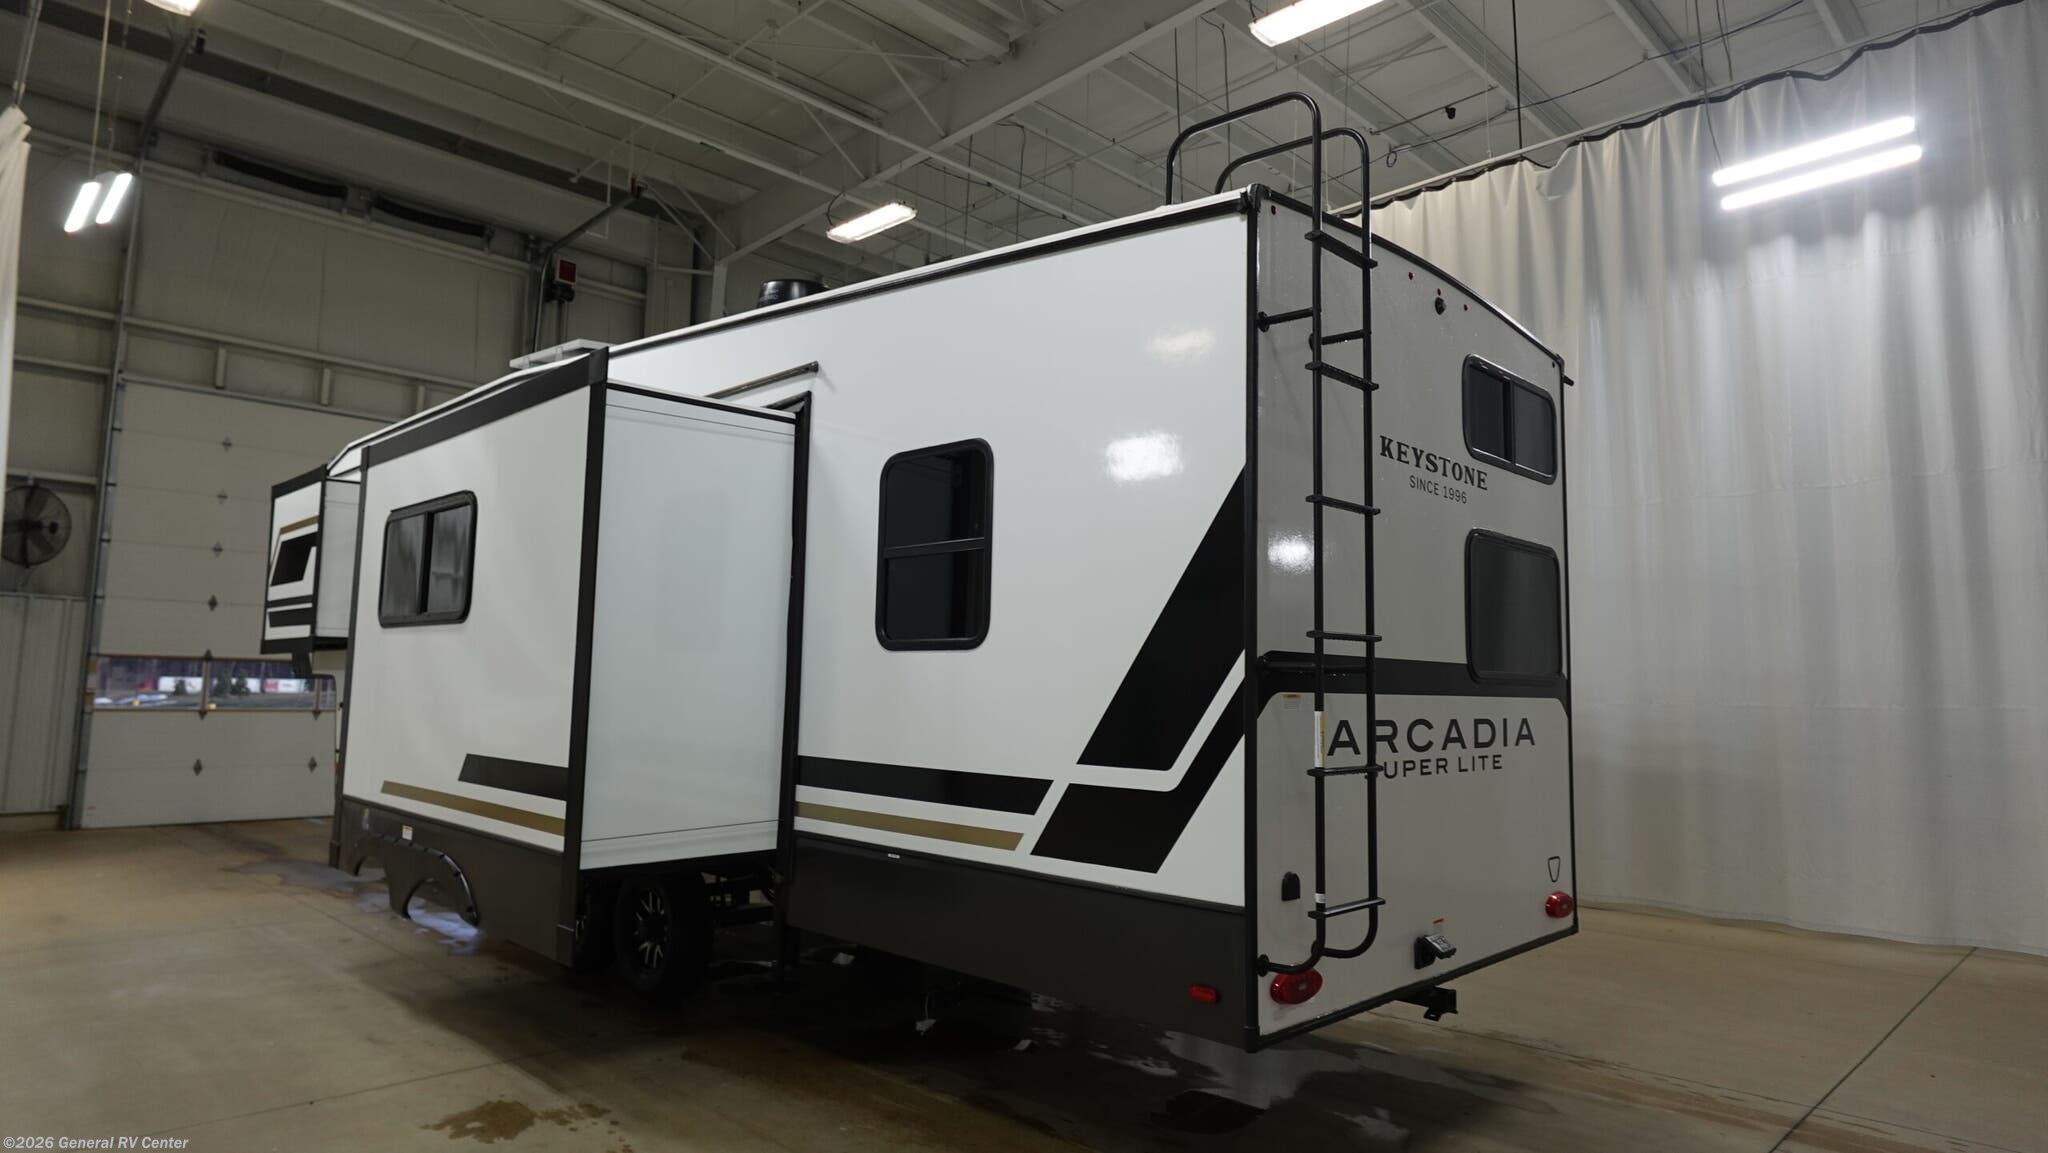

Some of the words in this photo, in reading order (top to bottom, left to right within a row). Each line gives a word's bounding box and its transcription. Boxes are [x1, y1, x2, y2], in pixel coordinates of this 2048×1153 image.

[1380, 435, 1488, 490] KEYSTONE
[1409, 475, 1439, 496] SINCE
[1443, 486, 1468, 504] 1996
[1327, 717, 1536, 756] ARCADIA
[1379, 757, 1448, 779] UPER
[1458, 754, 1503, 773] LITE
